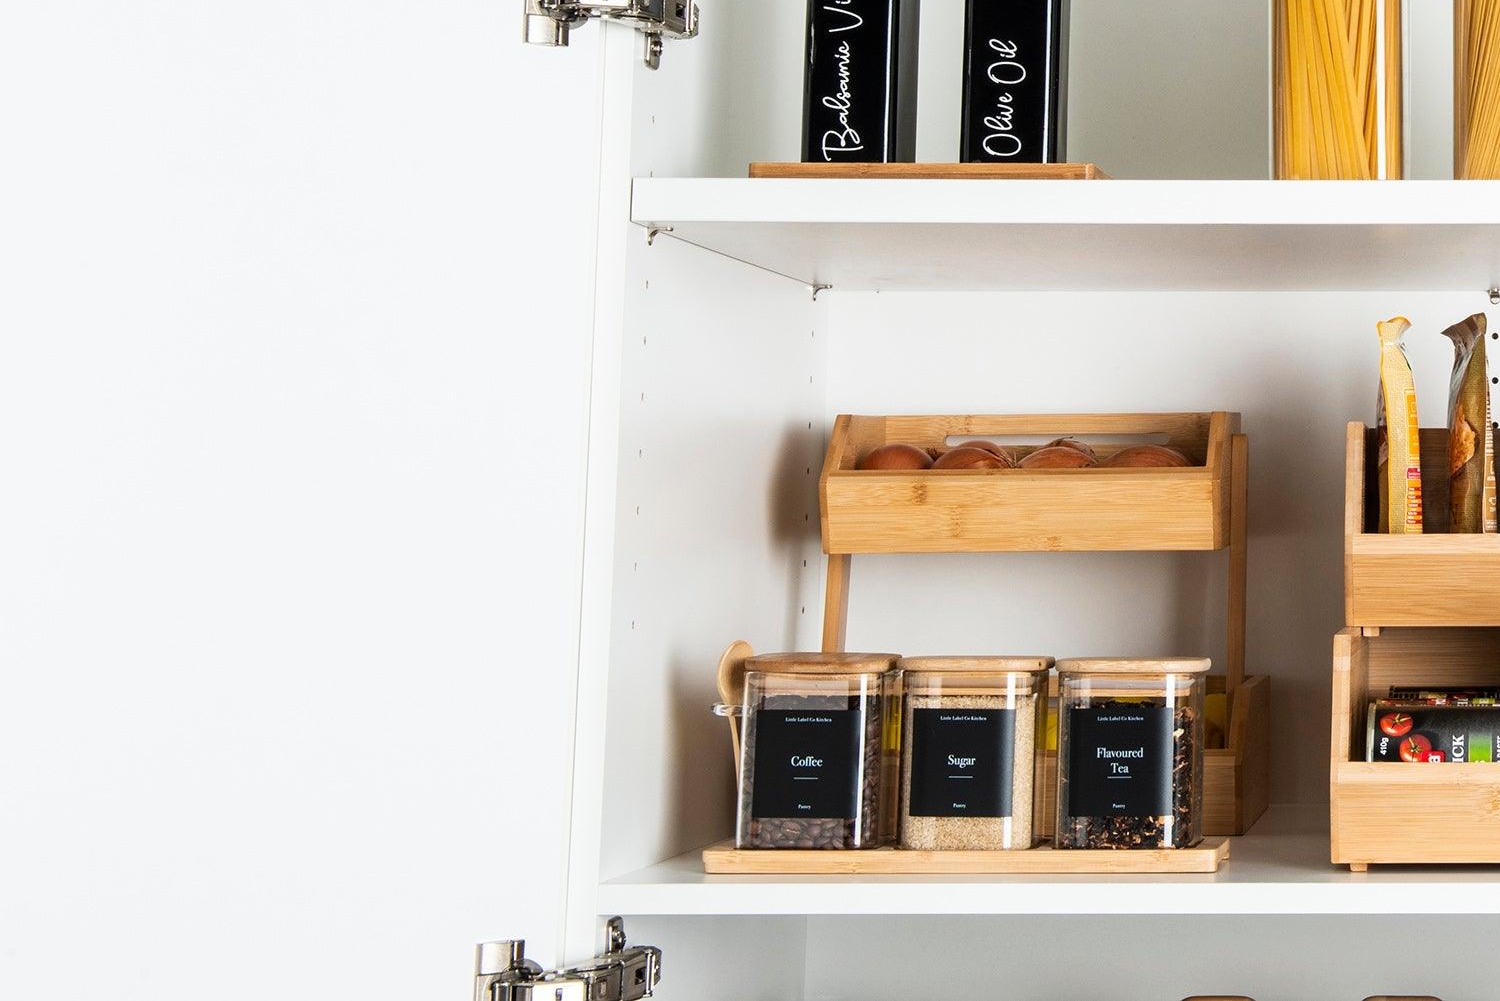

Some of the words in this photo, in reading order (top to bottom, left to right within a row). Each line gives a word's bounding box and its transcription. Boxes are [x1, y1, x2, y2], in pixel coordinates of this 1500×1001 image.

[987, 38, 1027, 85] Oil
[821, 41, 864, 161] Balsamic
[982, 92, 1022, 157] Olive
[1096, 747, 1144, 759] Flavoured
[1379, 736, 1390, 756] 410g
[790, 756, 823, 768] Coffee
[947, 754, 976, 768] Sugar
[1110, 762, 1129, 774] Tea
